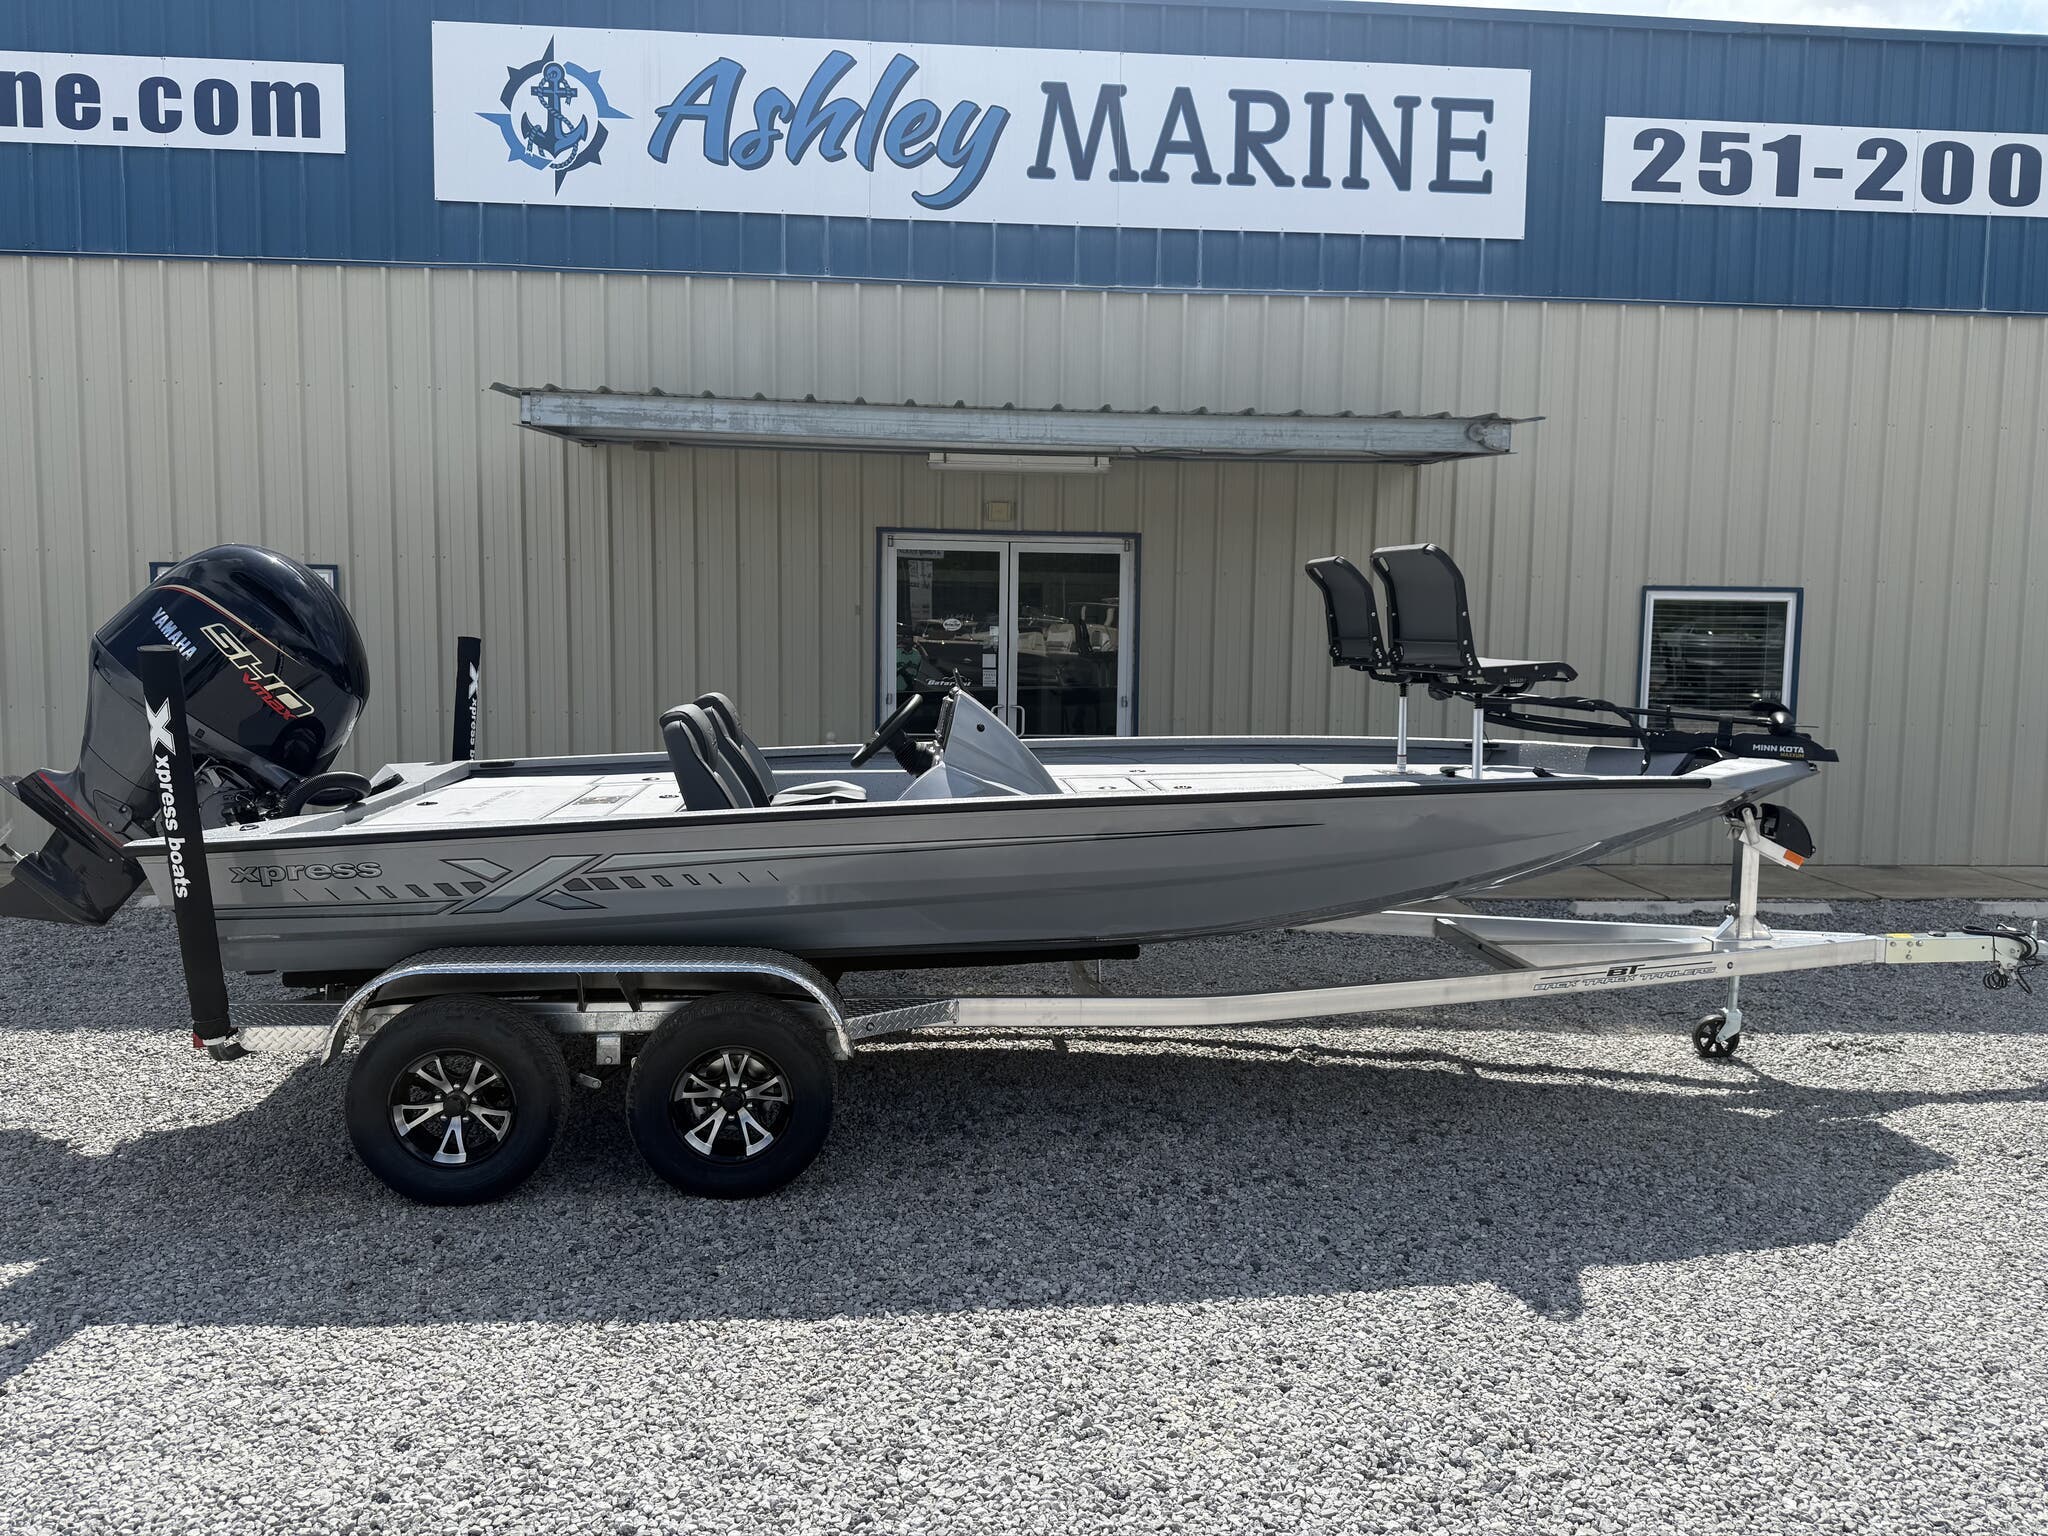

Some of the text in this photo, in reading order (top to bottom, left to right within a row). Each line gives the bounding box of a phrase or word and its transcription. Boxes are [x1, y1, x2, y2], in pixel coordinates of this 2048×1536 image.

[646, 49, 1494, 211] Ashley MARINE
[1631, 127, 2043, 207] 251-200
[151, 606, 198, 662] YAMAHA
[200, 623, 315, 718] SHO
[1752, 743, 1805, 753] MINN KOTA
[155, 754, 178, 831] xpress
[167, 836, 191, 899] boats
[229, 861, 383, 887] xpress
[1533, 966, 1717, 991] BACK TRACK TRAILERS
[1606, 964, 1646, 977] BT
